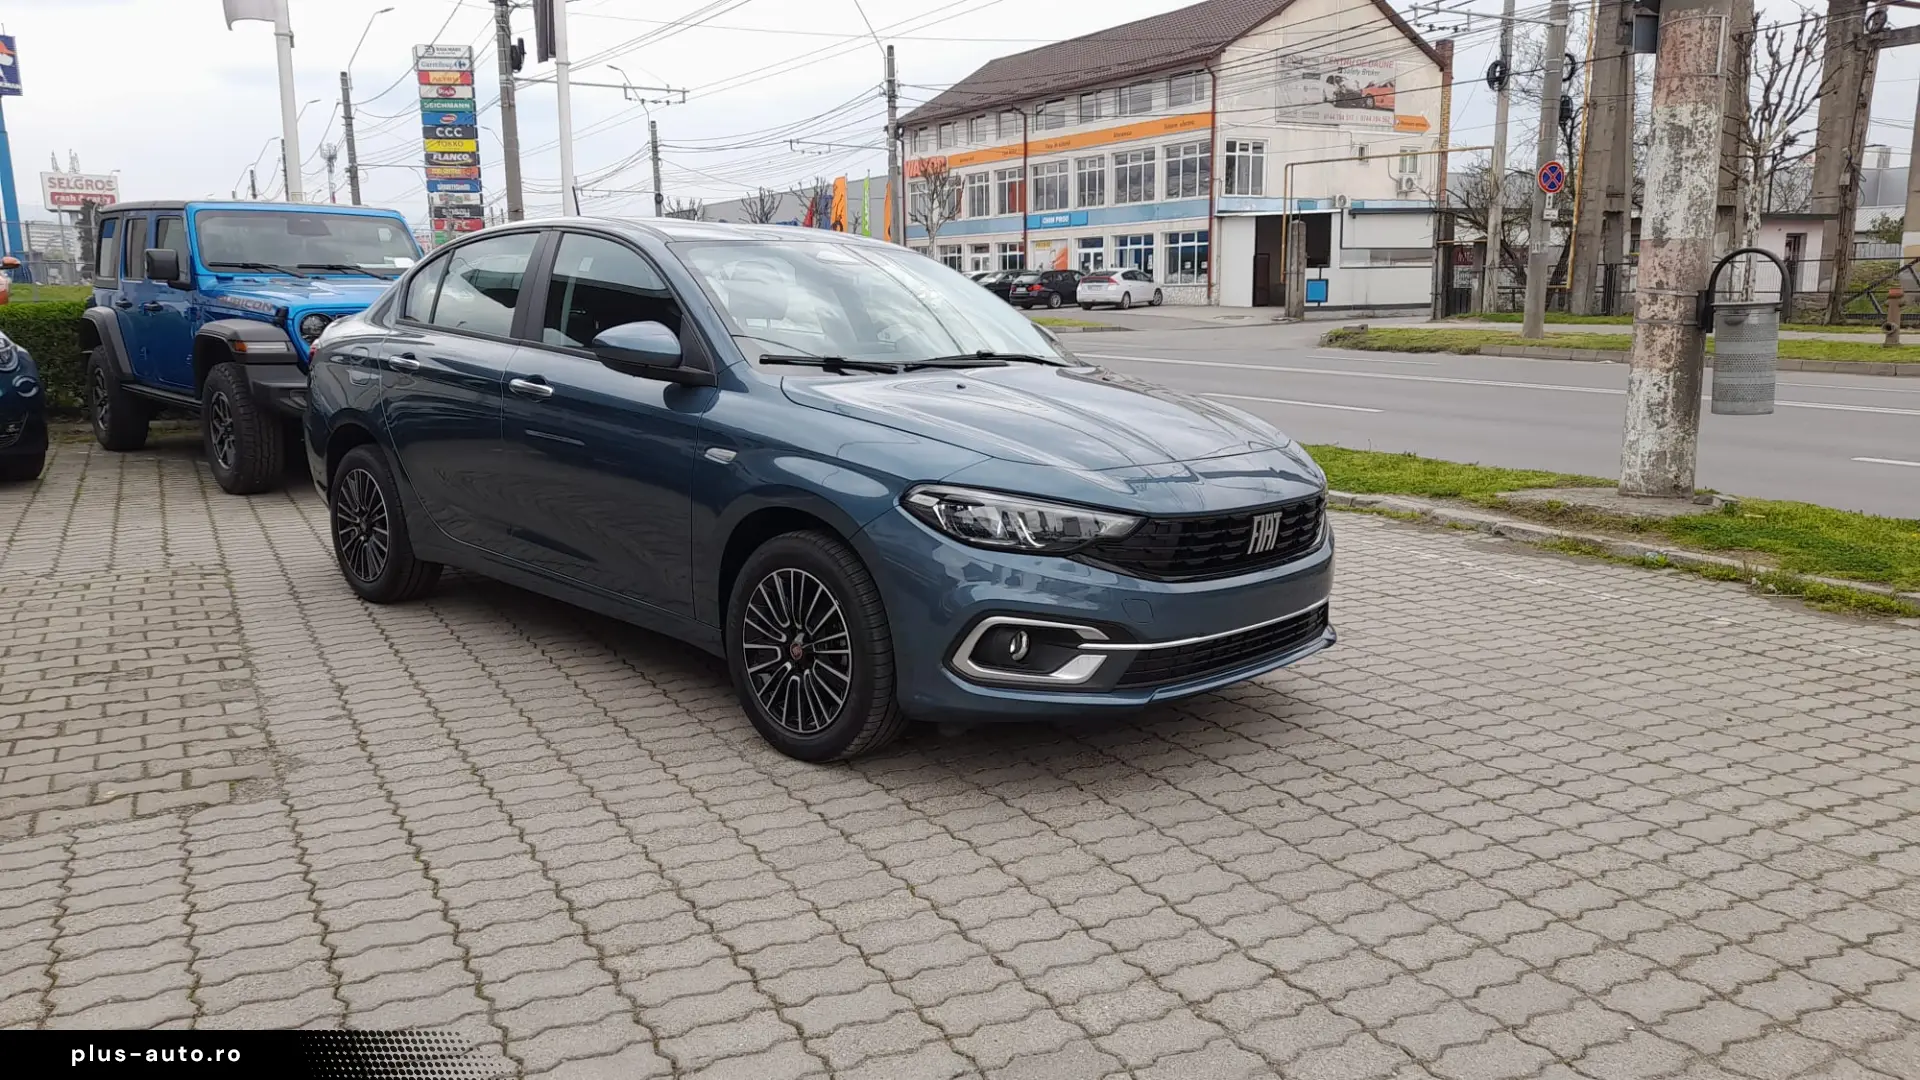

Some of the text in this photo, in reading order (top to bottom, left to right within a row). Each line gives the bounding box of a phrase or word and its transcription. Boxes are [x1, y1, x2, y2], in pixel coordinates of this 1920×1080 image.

[1368, 60, 1394, 69] DAUNE
[435, 127, 463, 137] CCC
[48, 176, 115, 191] SELGROS
[54, 194, 76, 202] cash
[217, 296, 273, 312] RUBICON
[1247, 511, 1283, 554] FIAT
